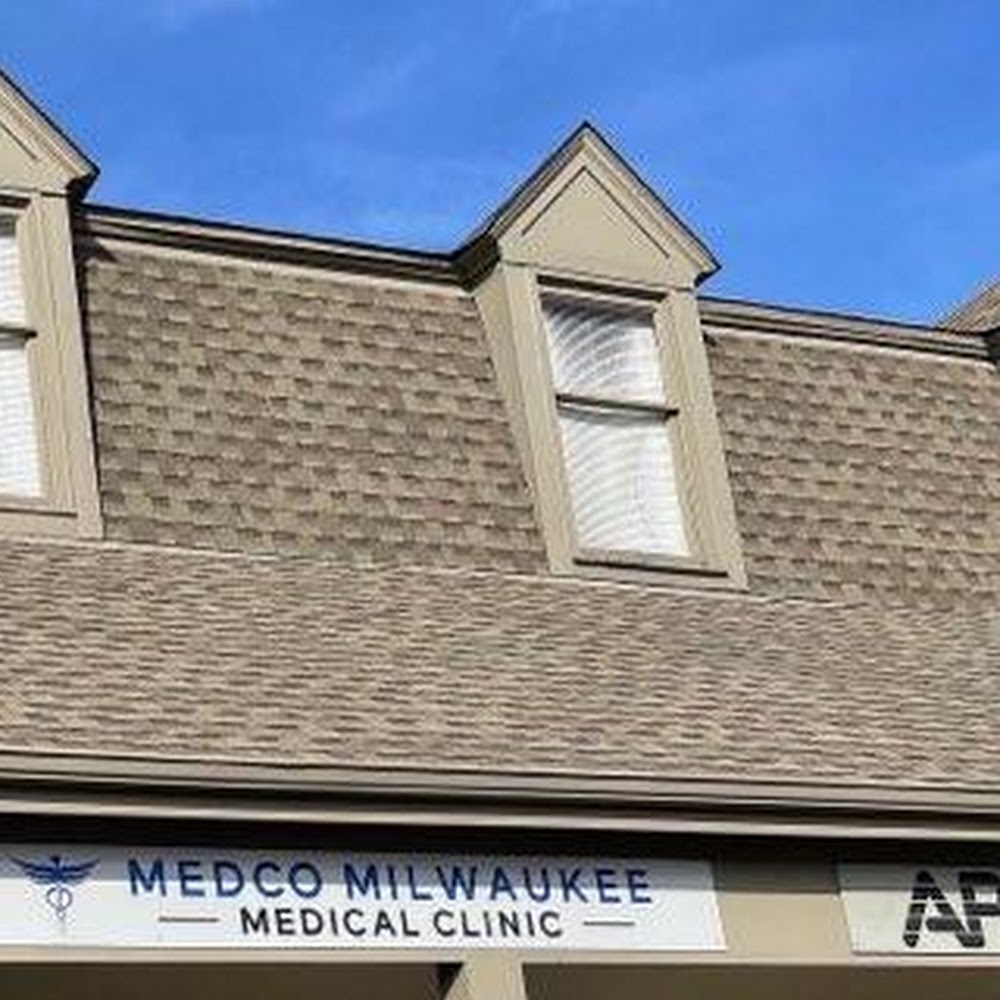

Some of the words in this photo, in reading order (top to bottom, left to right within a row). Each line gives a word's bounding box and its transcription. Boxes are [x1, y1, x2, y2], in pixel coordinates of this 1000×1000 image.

[127, 858, 323, 899] MEDCO
[342, 861, 654, 903] MILWAUKEE
[239, 907, 420, 937] MEDICAL
[432, 909, 563, 938] CLINIC
